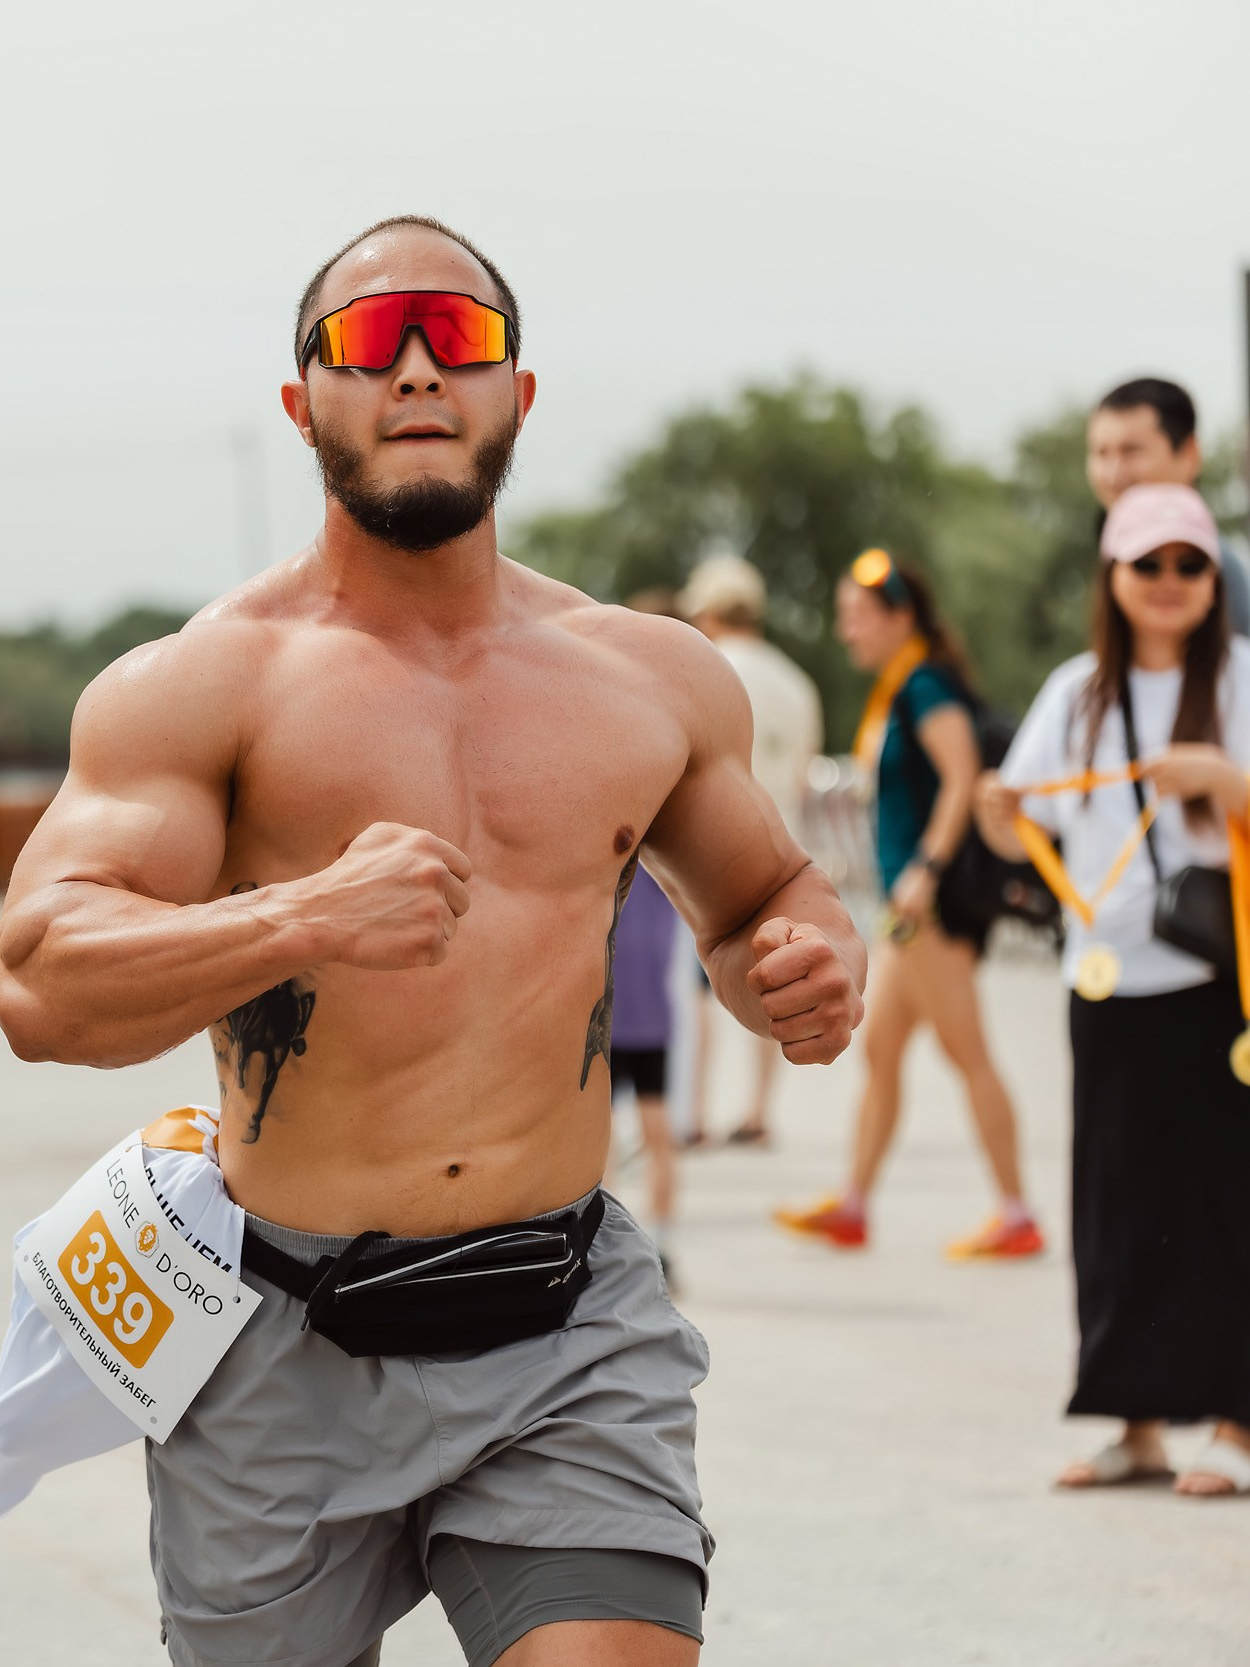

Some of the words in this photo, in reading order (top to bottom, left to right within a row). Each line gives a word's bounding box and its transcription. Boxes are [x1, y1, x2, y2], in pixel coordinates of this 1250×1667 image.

[106, 1158, 140, 1229] LEONE
[32, 1252, 122, 1378] БЛАГОТВОРИТЕЛЬНЫЙ
[119, 1374, 157, 1408] ЗАБЕГ
[70, 1231, 153, 1345] 339
